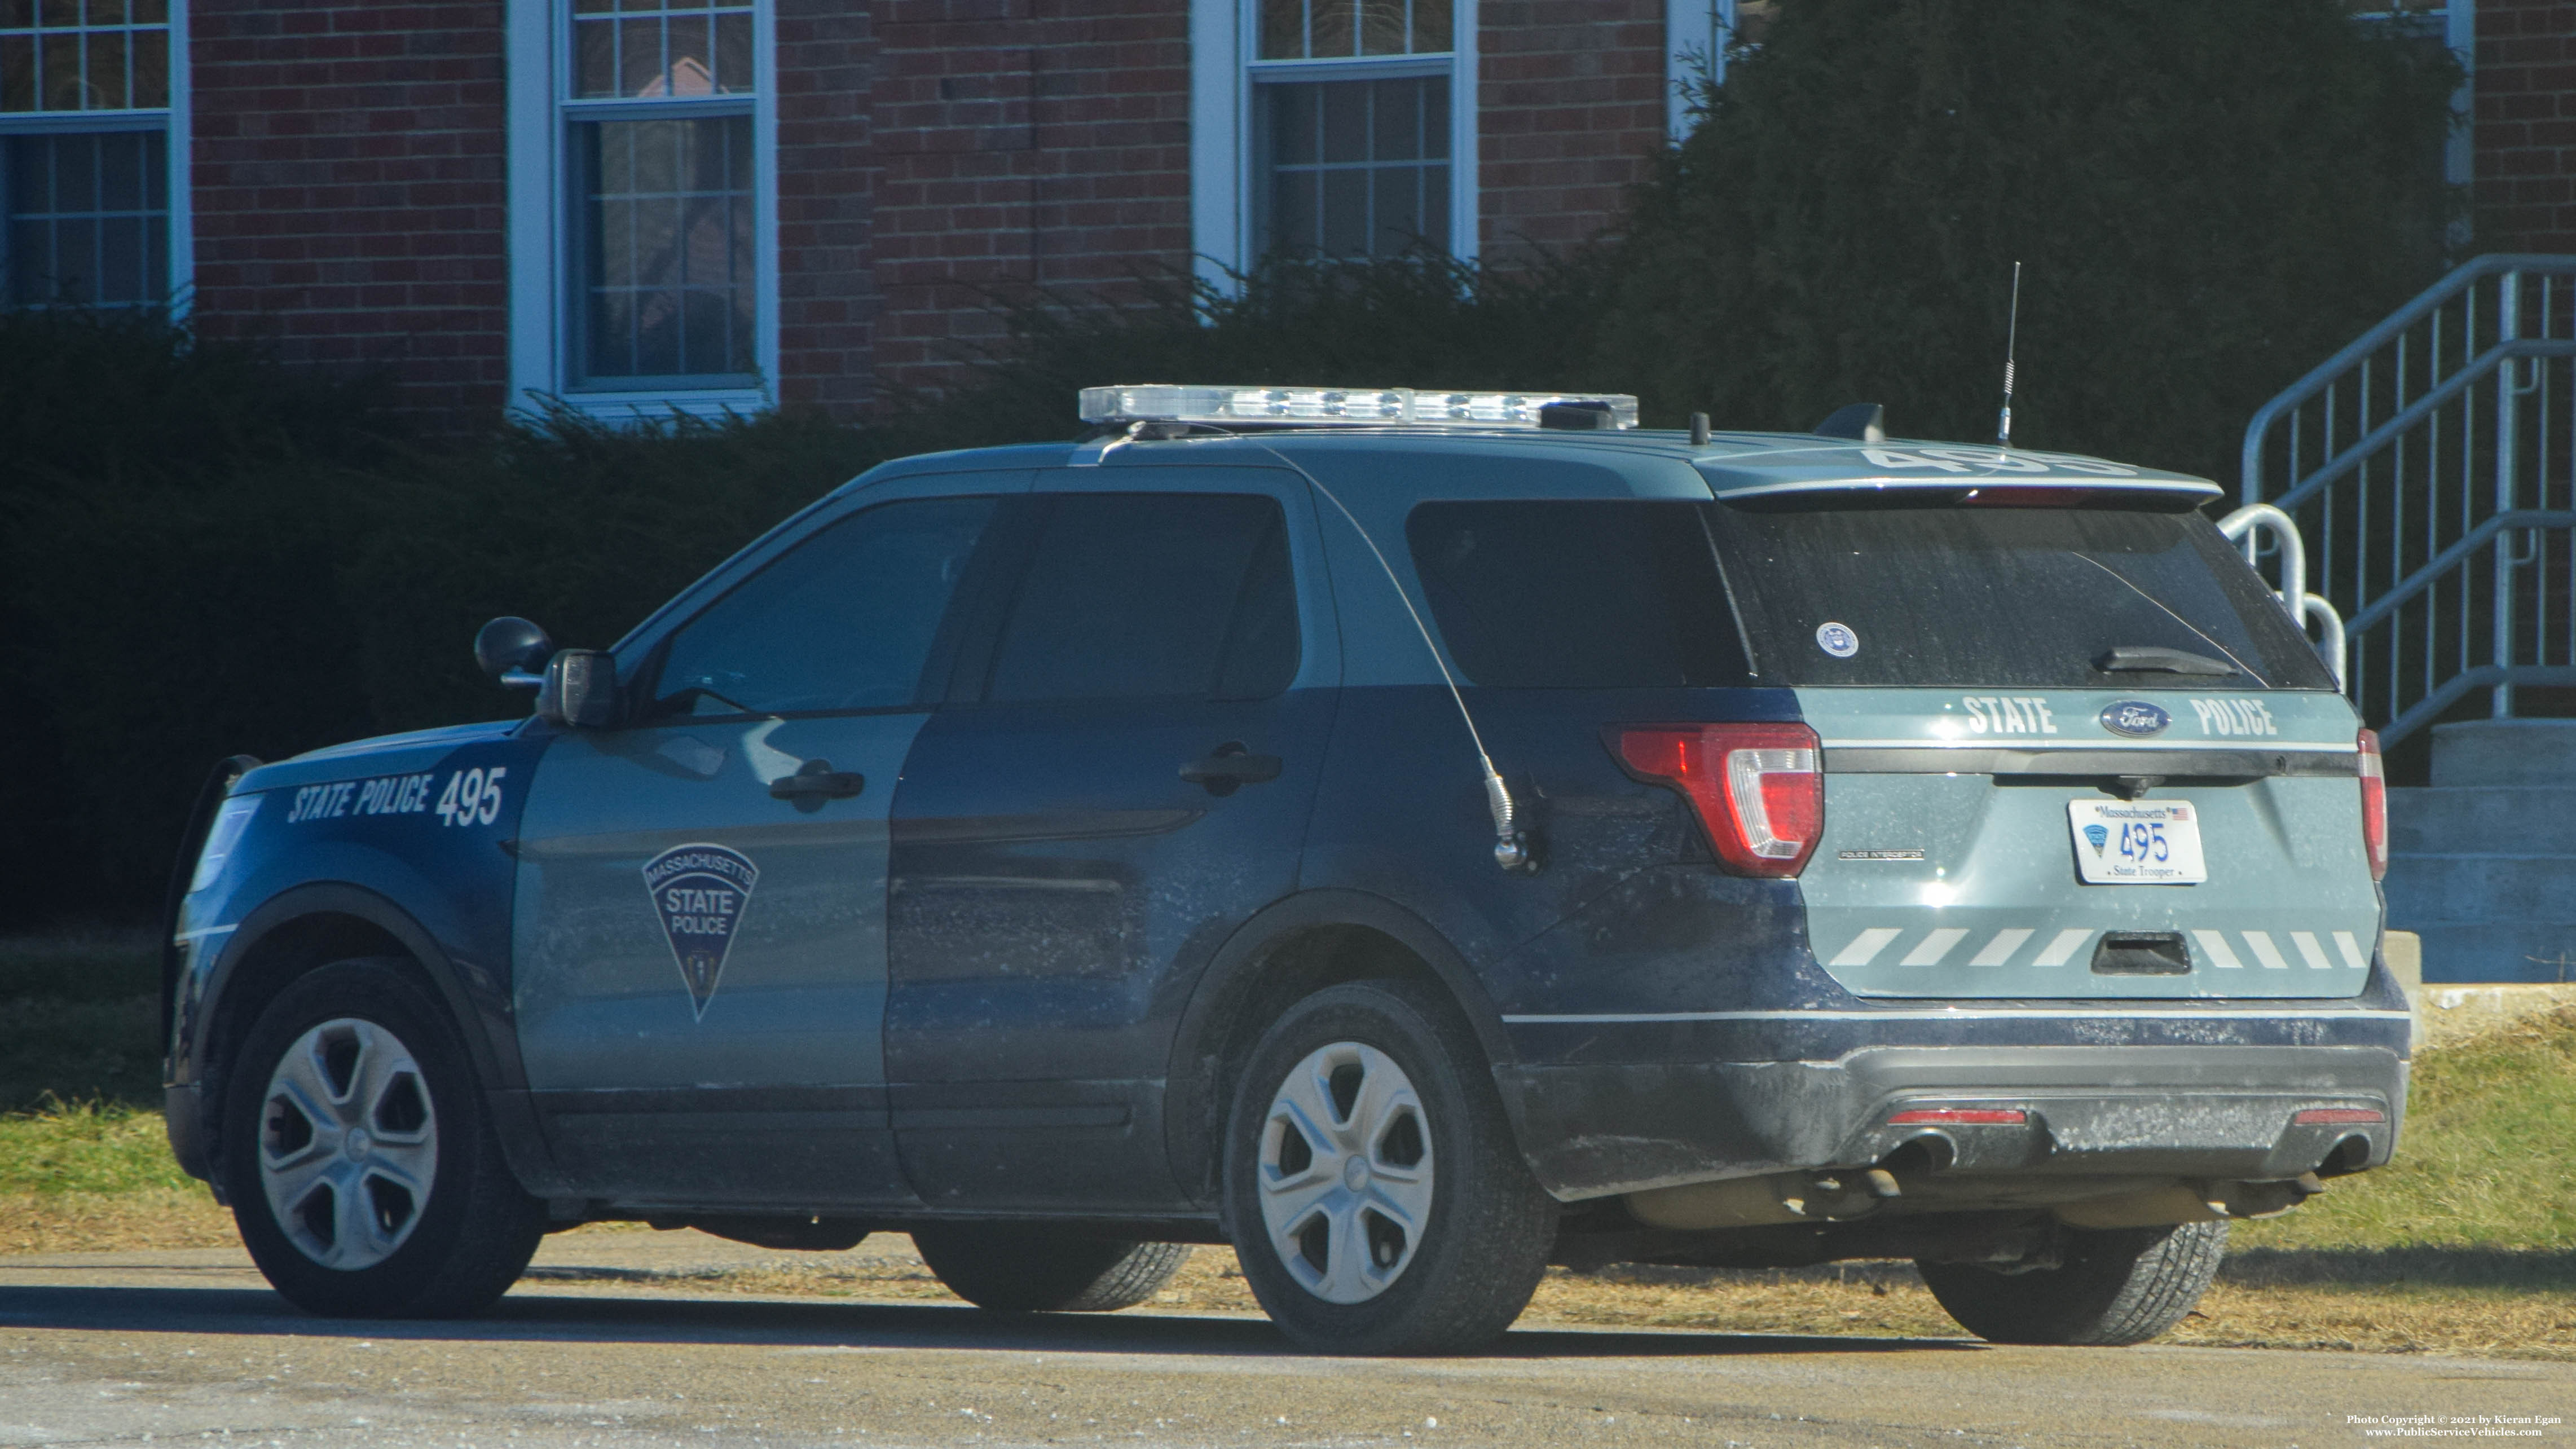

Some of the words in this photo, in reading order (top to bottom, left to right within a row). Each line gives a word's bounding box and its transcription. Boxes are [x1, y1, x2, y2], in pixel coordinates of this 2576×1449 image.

[1861, 450, 2138, 476] 495
[1962, 697, 2058, 734] STATE
[2121, 706, 2159, 729] Ford
[2189, 699, 2278, 735] POLICE
[287, 782, 356, 823] STATE
[353, 774, 434, 816] POLICE
[435, 767, 507, 827] 495
[2099, 805, 2166, 818] Massachusetts
[2120, 822, 2169, 862] 495
[649, 853, 756, 886] MASSACHUSETTS
[2113, 865, 2137, 876] State
[2138, 865, 2174, 879] Trooper
[666, 888, 734, 914] STATE
[672, 915, 728, 935] POLICE
